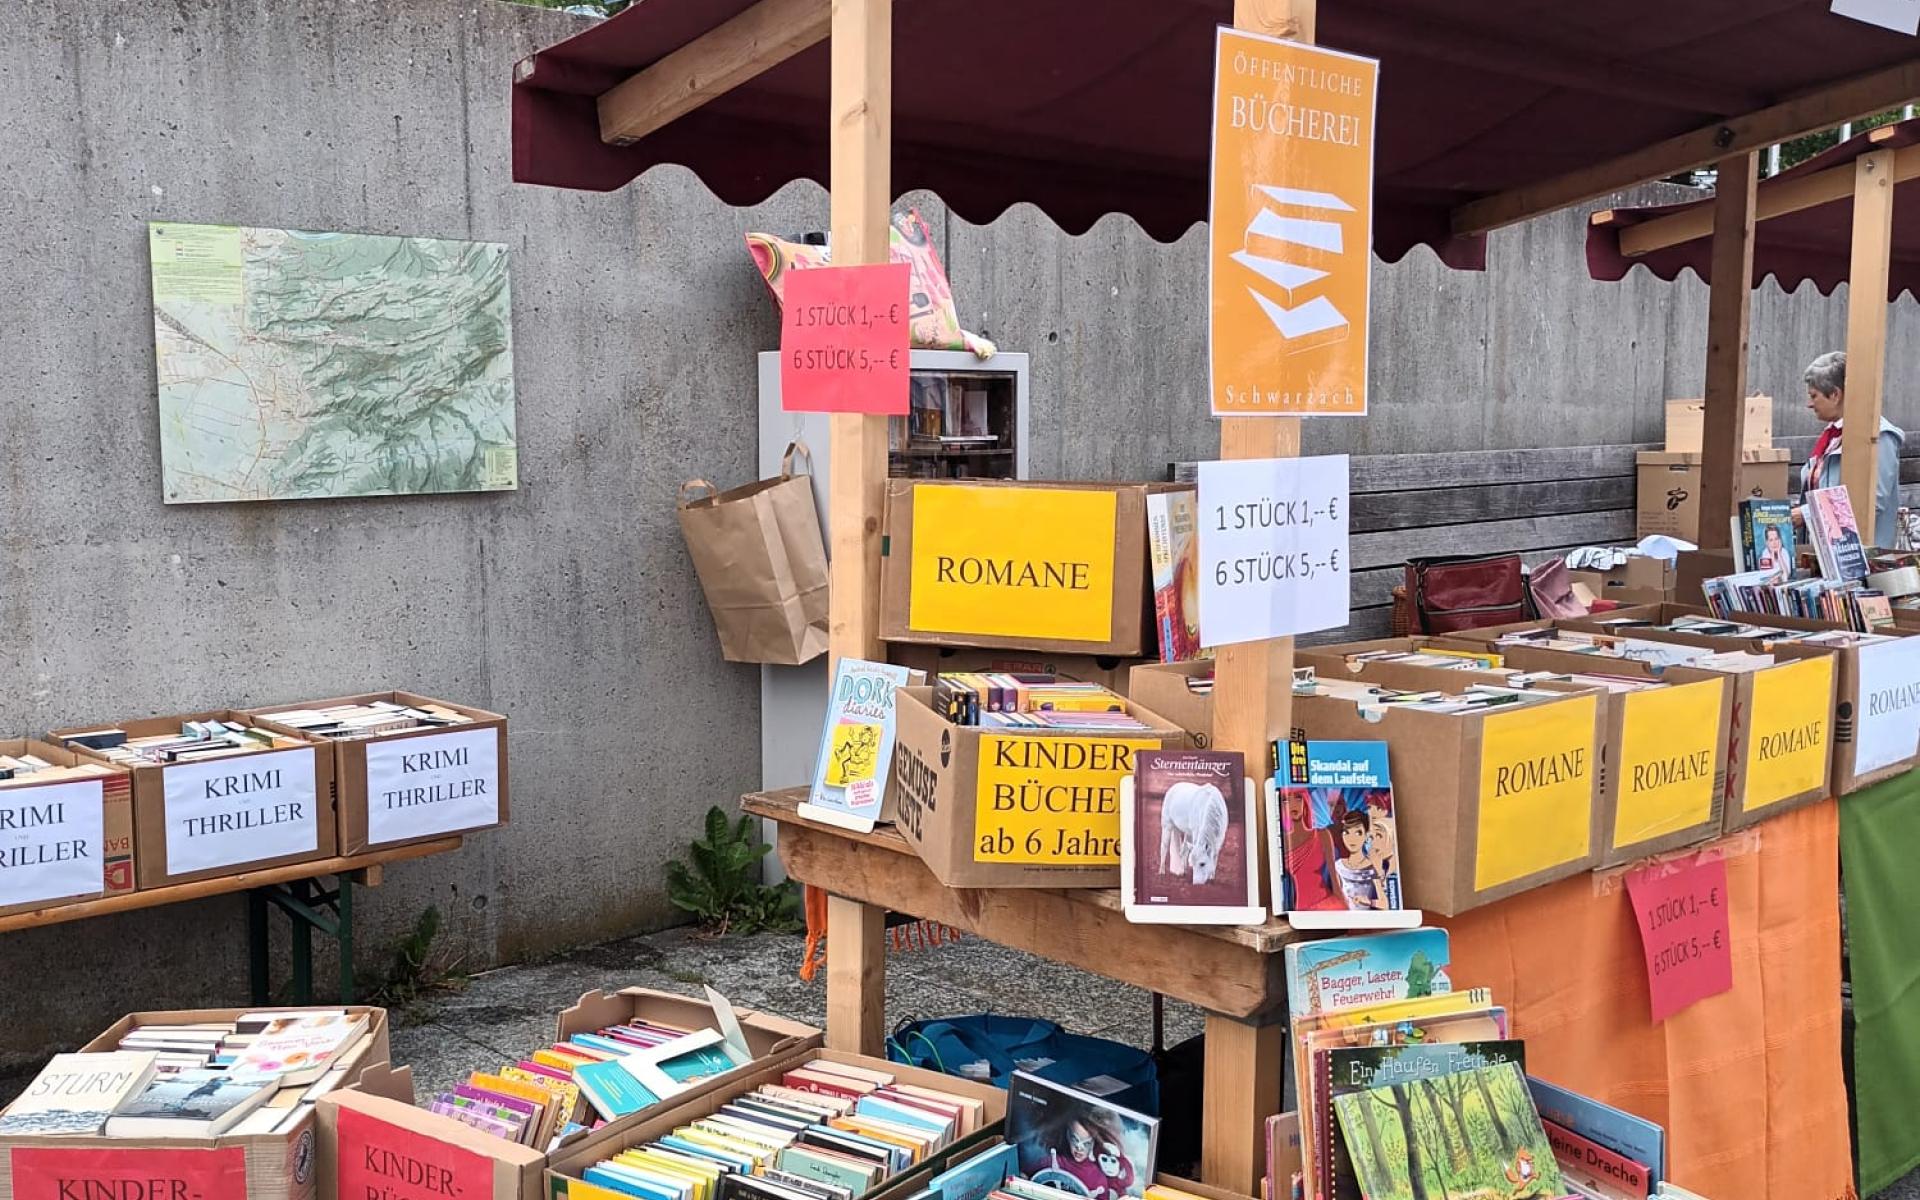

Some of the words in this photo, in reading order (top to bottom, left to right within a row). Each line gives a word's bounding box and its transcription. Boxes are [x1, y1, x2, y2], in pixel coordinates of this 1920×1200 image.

[1233, 51, 1363, 97] ÖFFENTLICHE
[1230, 93, 1361, 147] BÜCHEREI
[795, 307, 803, 326] 1
[808, 302, 856, 326] STÜCK
[889, 304, 898, 325] €
[794, 349, 802, 369] 6
[806, 346, 855, 369] STÜCK
[889, 349, 898, 369] €
[1226, 385, 1354, 405] Schwarzach
[1216, 506, 1228, 530] 1
[1234, 497, 1297, 529] STÜCK
[1329, 497, 1338, 520] €
[936, 556, 1089, 590] ROMANE
[1216, 560, 1227, 585] 6
[1234, 551, 1296, 584] STÜCK
[1330, 549, 1340, 572] €
[839, 674, 896, 710] DORK
[1869, 681, 1920, 716] ROMANE
[1290, 741, 1305, 755] Die
[1759, 719, 1821, 761] ROMANE
[401, 747, 468, 773] KRIMI
[1150, 757, 1232, 777] Sternentänzer
[1310, 759, 1351, 772] Skandal
[1352, 759, 1369, 772] auf
[1495, 747, 1584, 797] ROMANE
[1632, 749, 1710, 792] ROMANE
[205, 769, 283, 798] KRIMI
[382, 778, 487, 809] THRILLER
[1311, 774, 1333, 784] dem
[1334, 773, 1378, 787] Laufsteg
[994, 779, 1120, 813] BÜCHE
[0, 803, 64, 829] RIMI
[183, 802, 304, 837] THRILLER
[0, 839, 89, 868] RILLER
[980, 827, 1015, 855] ab
[1025, 828, 1042, 854] 6
[1648, 911, 1655, 930] 1
[1657, 895, 1686, 927] STÜCK
[1710, 887, 1719, 907] €
[1654, 955, 1661, 976] 6
[1660, 940, 1689, 973] STÜCK
[1713, 930, 1722, 949] €
[1321, 975, 1364, 992] Bagger,
[1367, 970, 1404, 984] Laster,
[1332, 983, 1395, 1007] Feuerwehr!
[31, 1070, 135, 1098] STURM
[1349, 1060, 1373, 1085] Ein
[1382, 1054, 1440, 1081] Haufen
[365, 1144, 463, 1197] KINDER-
[1586, 1148, 1639, 1187] Drache
[57, 1179, 202, 1200] KINDER-
